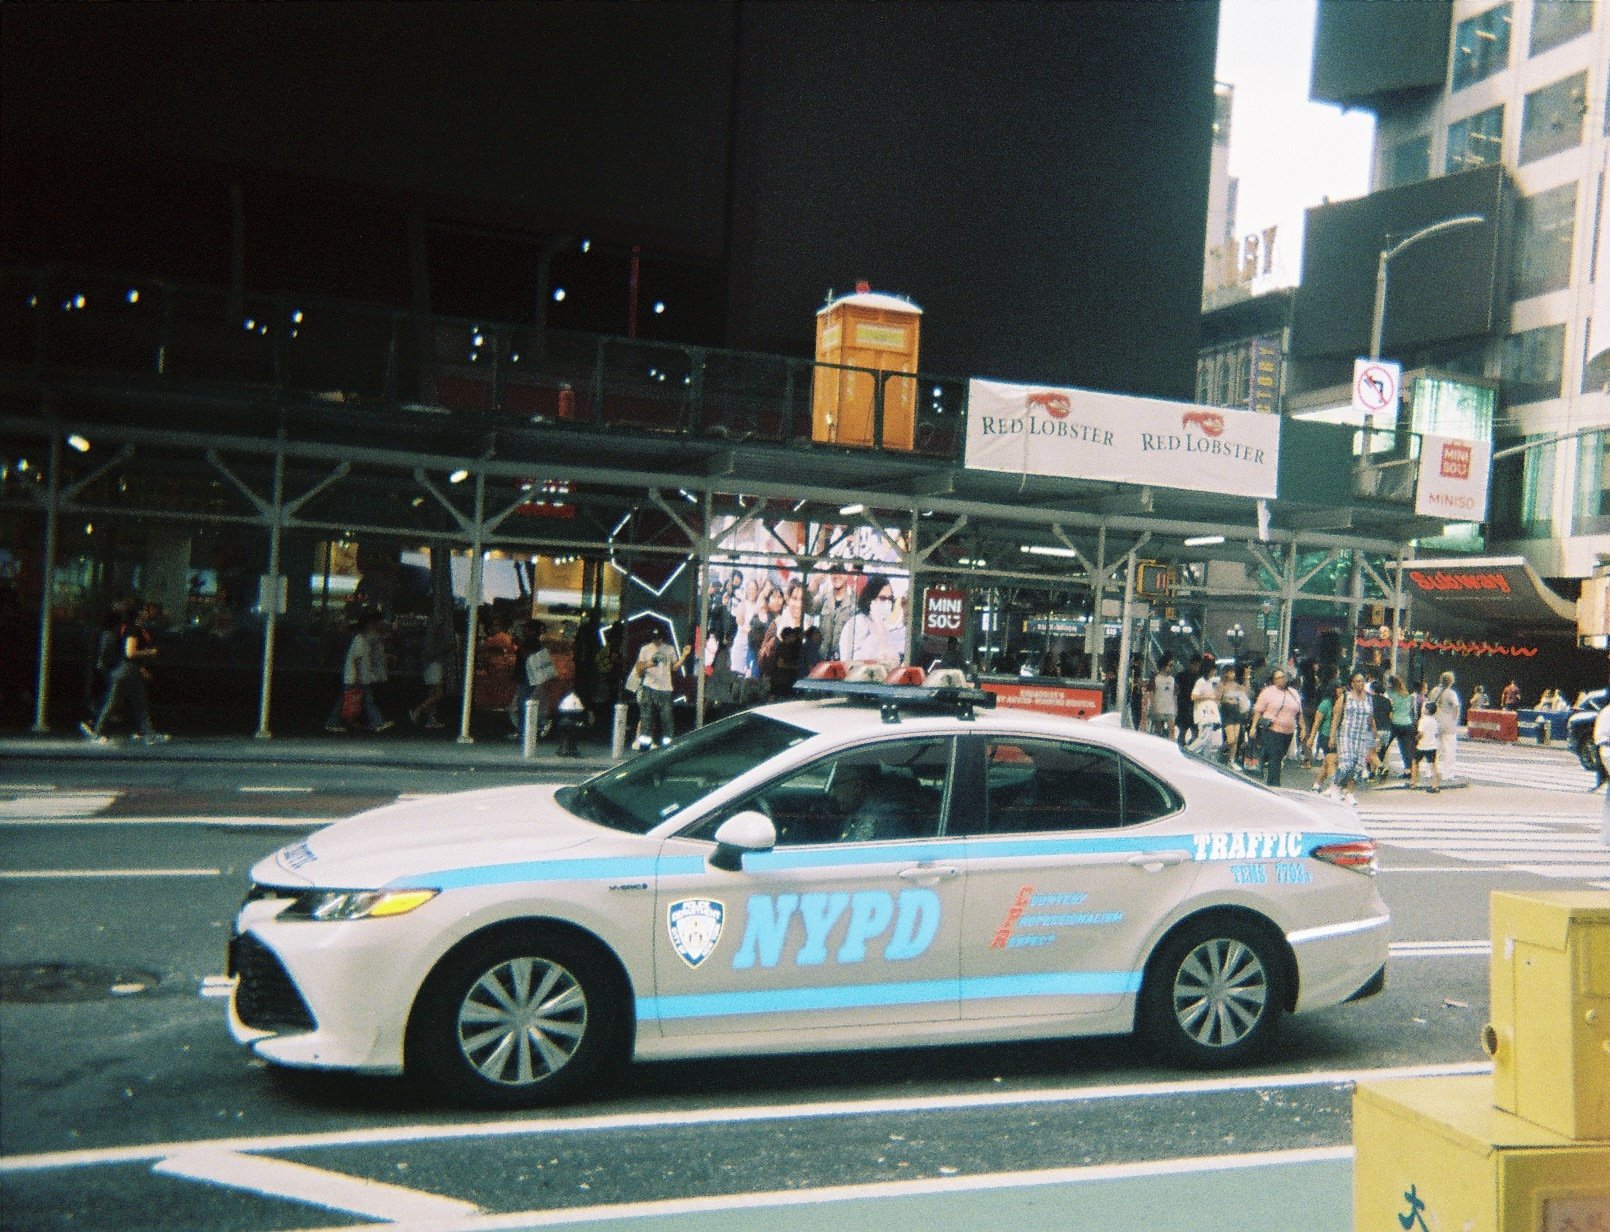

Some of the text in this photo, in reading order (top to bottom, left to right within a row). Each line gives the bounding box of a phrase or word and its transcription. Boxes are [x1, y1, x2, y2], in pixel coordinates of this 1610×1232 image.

[982, 415, 1114, 447] RED LOBSTER
[1142, 432, 1265, 464] RED LOBSTER
[1428, 492, 1475, 510] MINISO
[928, 597, 962, 613] MINI
[1193, 832, 1303, 861] TRAFFIC
[731, 887, 941, 970] NYPD
